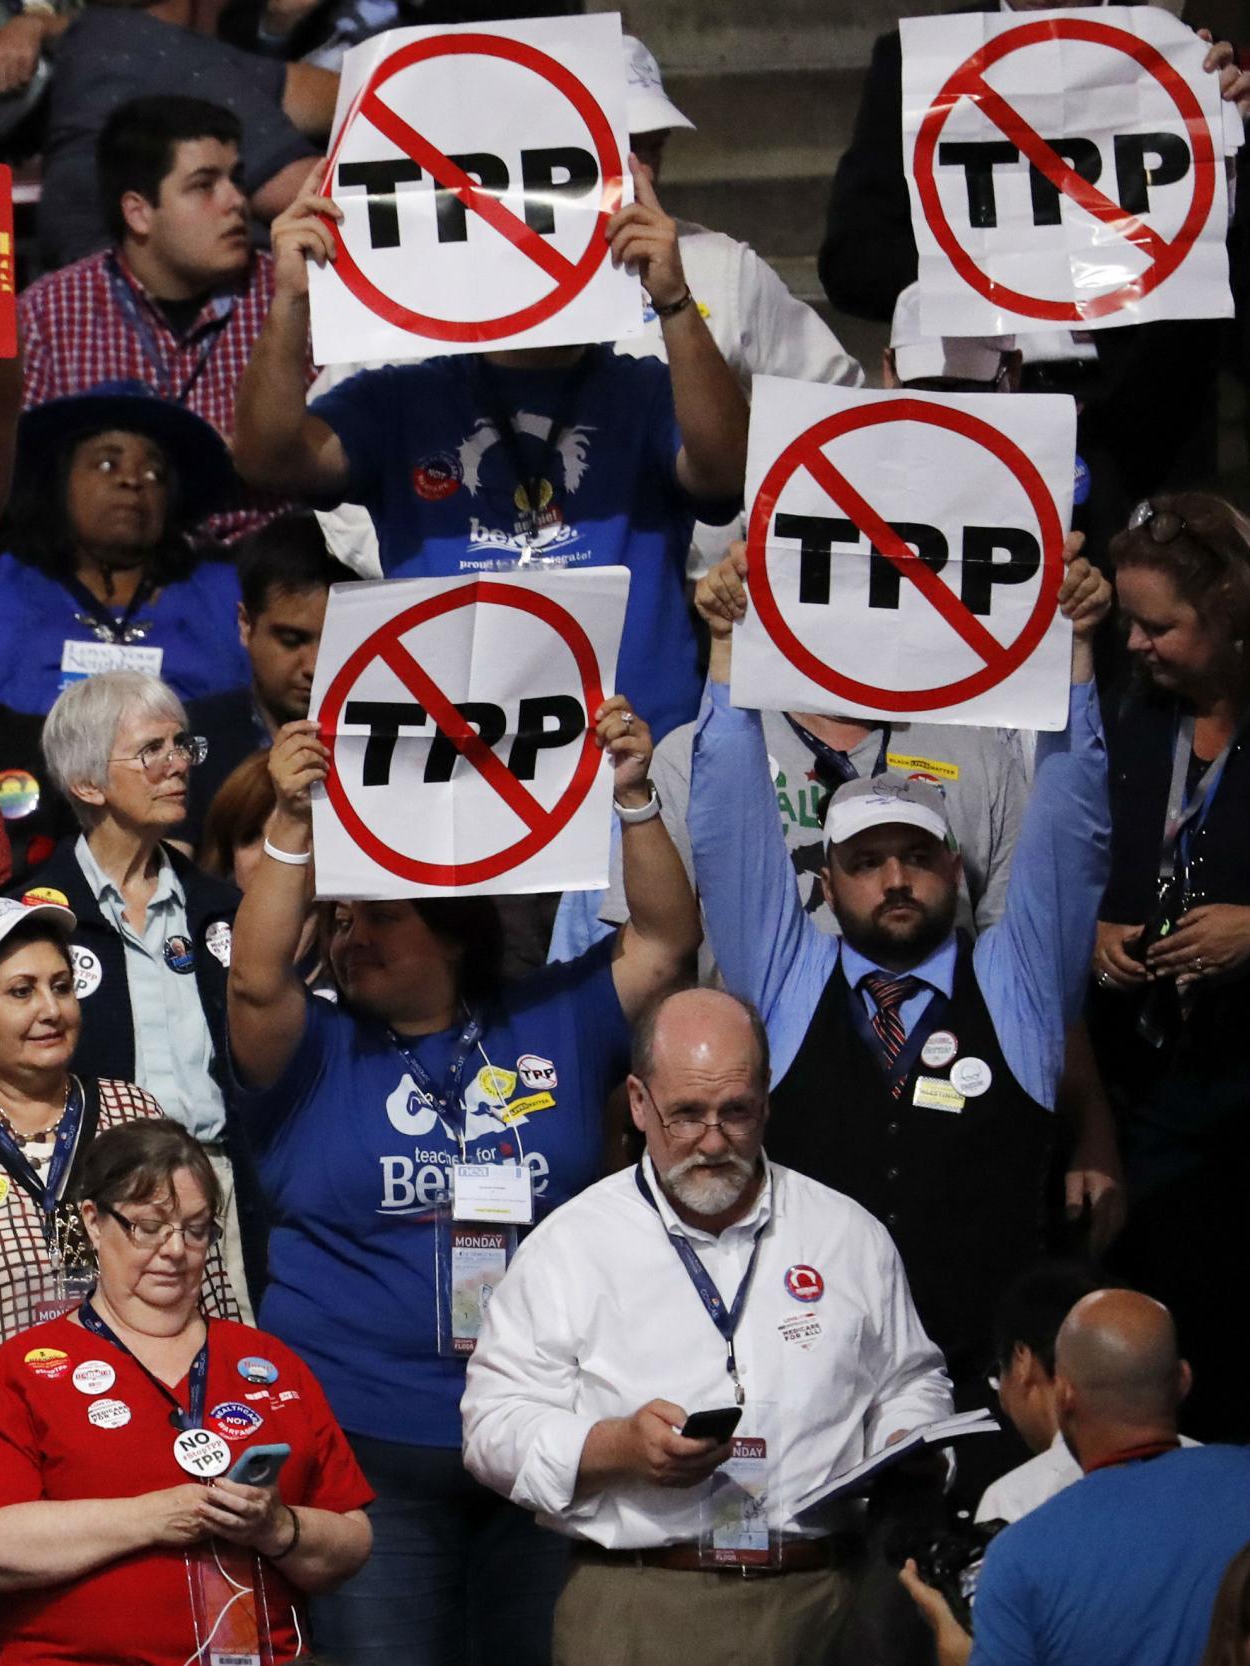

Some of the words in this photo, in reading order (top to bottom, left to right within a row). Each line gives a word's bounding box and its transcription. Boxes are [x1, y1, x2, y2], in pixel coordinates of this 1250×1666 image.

[939, 132, 1191, 228] TPP
[338, 146, 599, 249] TPP
[774, 513, 1042, 616] TPP
[344, 694, 586, 787] TPP
[521, 1068, 554, 1081] TPP
[415, 1147, 460, 1165] teache
[476, 1147, 497, 1163] for
[379, 1150, 550, 1207] Bee
[455, 1236, 503, 1249] MONDAY
[39, 1309, 66, 1321] MON
[226, 1416, 248, 1426] NOT
[178, 1432, 210, 1452] NO
[183, 1440, 222, 1460] #StopTPP
[192, 1450, 224, 1471] TPP
[732, 1447, 763, 1458] NDAY
